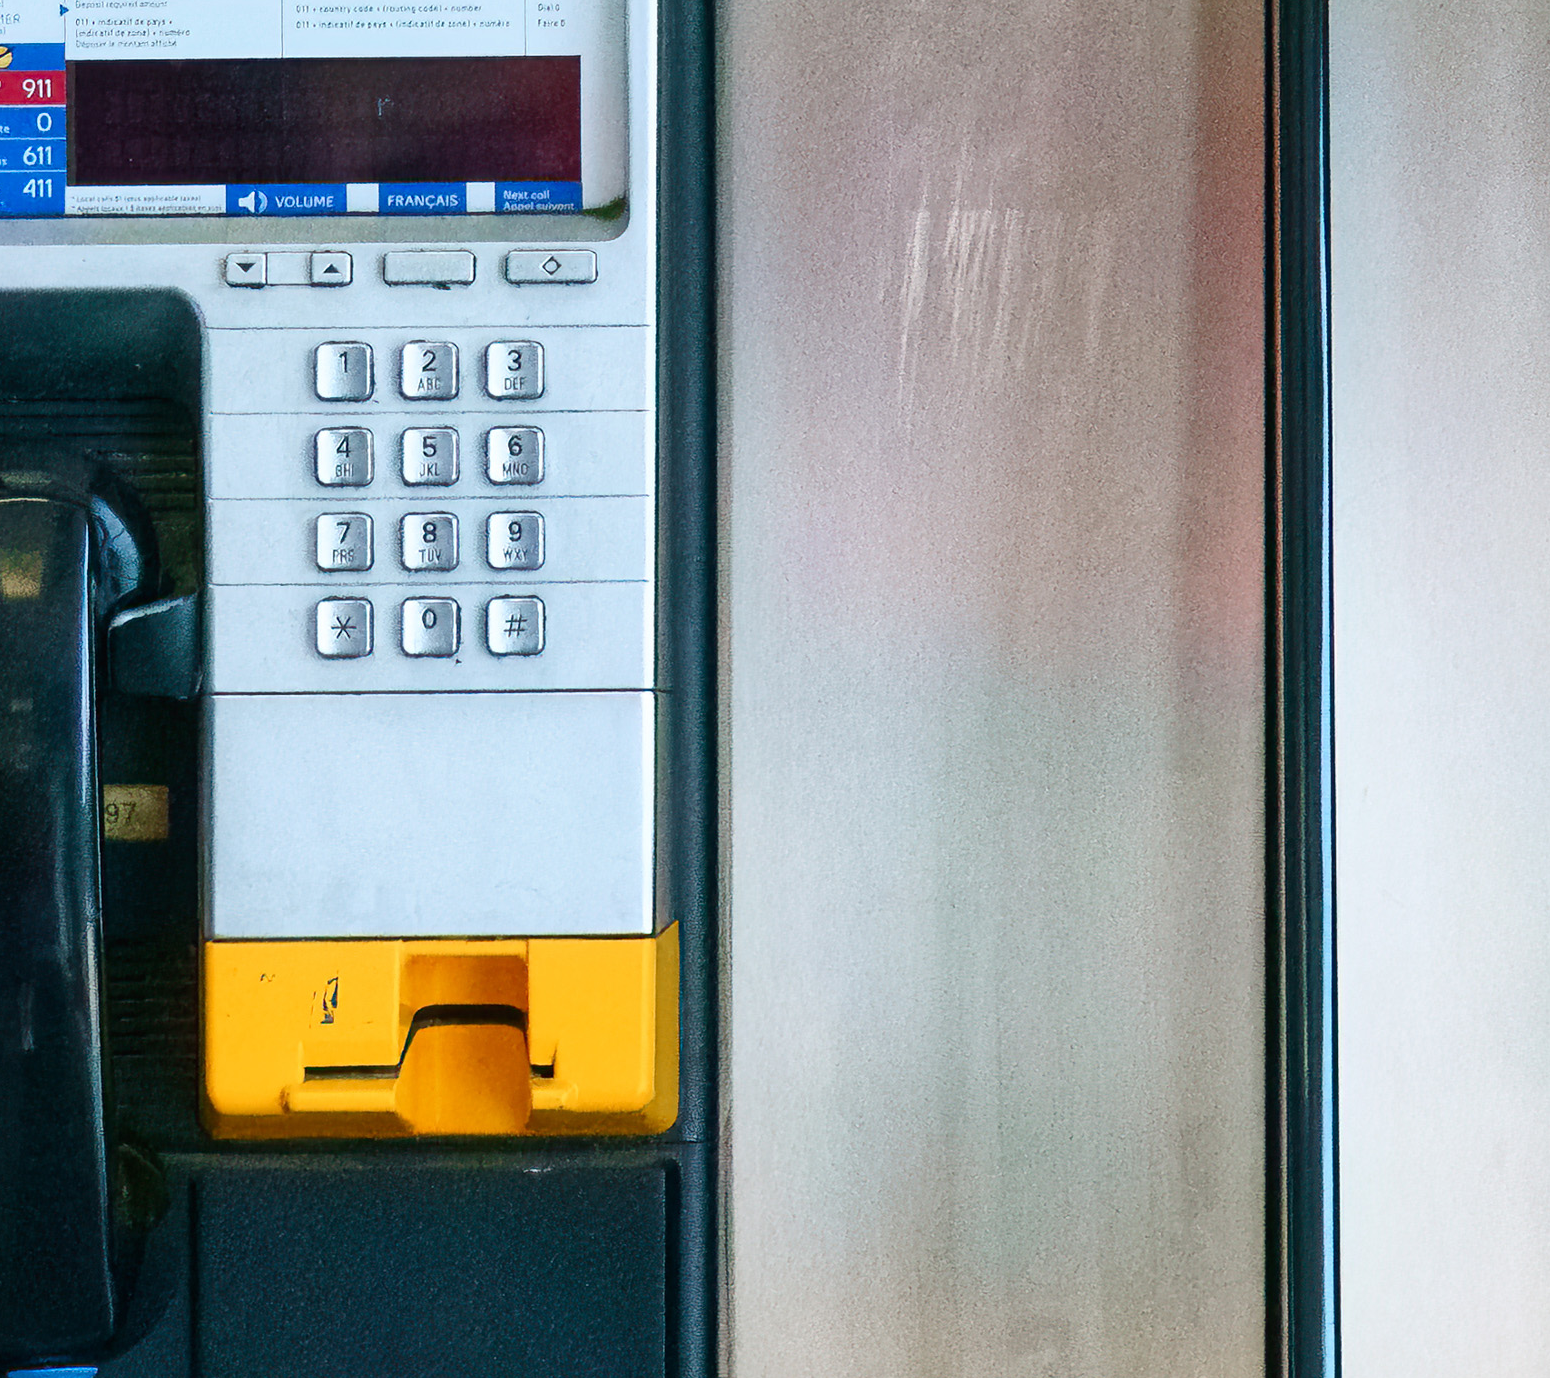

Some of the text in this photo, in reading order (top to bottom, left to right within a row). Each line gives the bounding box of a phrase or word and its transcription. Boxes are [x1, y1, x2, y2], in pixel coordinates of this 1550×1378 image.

[22, 79, 52, 98] 911
[36, 112, 52, 132] 0
[22, 146, 52, 166] 611
[22, 179, 52, 198] 411
[503, 189, 550, 200] Next call
[275, 195, 334, 208] VOLUME
[387, 194, 459, 210] FRANÇAIS
[503, 201, 575, 213] Appel suivant
[337, 351, 349, 374] 1
[422, 350, 437, 373] 2
[507, 350, 522, 373] 3
[417, 377, 442, 391] ABC
[503, 377, 527, 391] DEF
[336, 435, 351, 459] 4
[422, 435, 437, 458] 5
[507, 435, 523, 457] 6
[419, 463, 440, 477] JKL
[336, 522, 351, 544] 7
[422, 522, 437, 543] 8
[508, 522, 523, 543] 9
[418, 549, 442, 563] TUV
[503, 548, 528, 562] WXY
[421, 608, 437, 630] 0
[503, 613, 527, 639] #
[105, 802, 137, 825] 97
